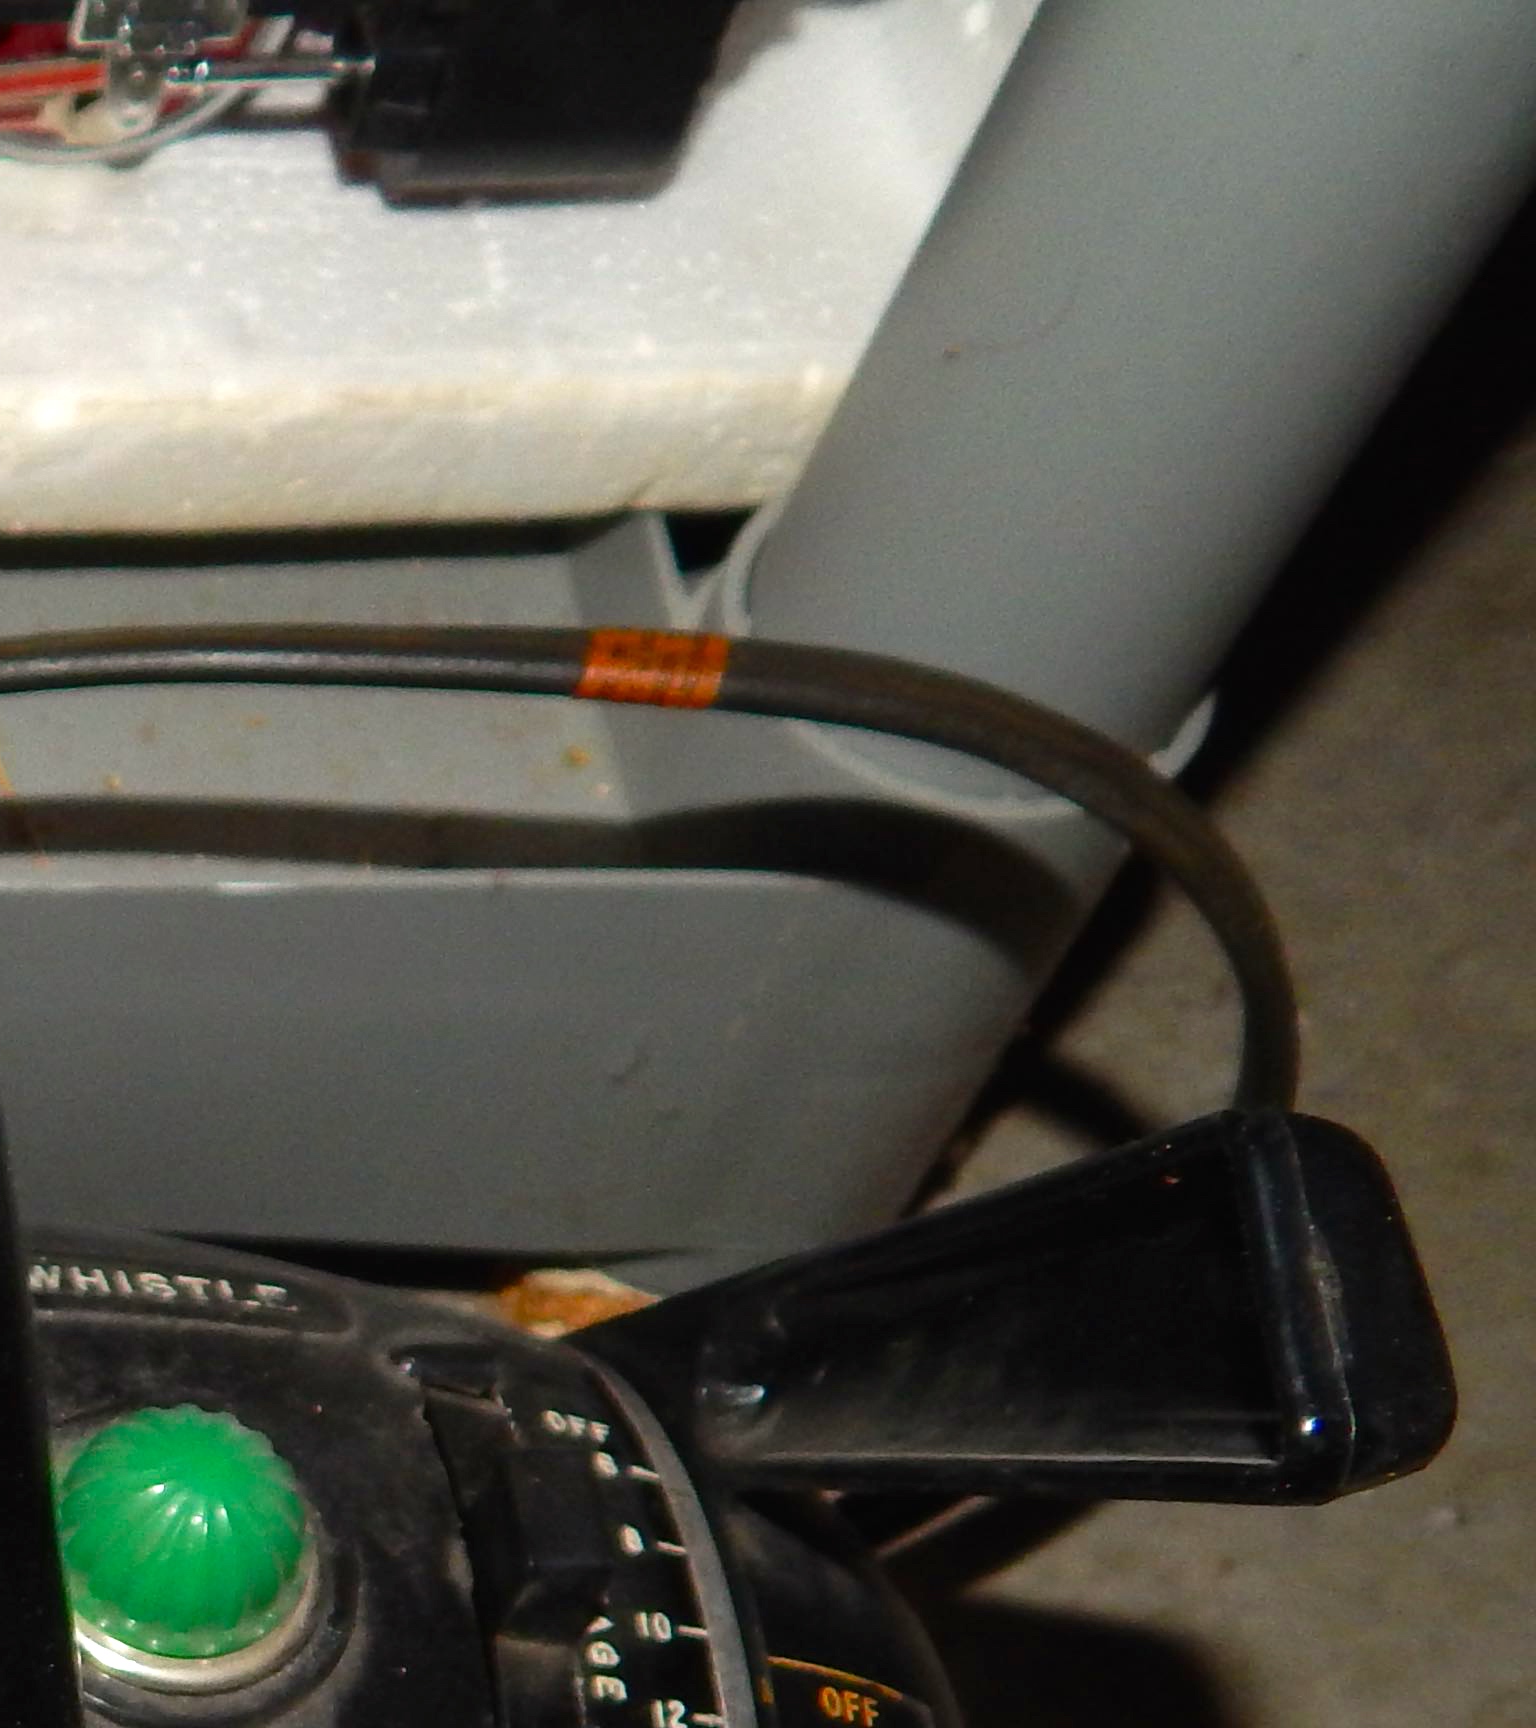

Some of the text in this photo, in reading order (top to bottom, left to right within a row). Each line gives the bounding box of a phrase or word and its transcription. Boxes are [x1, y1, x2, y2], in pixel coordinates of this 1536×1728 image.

[541, 1409, 611, 1443] OFF
[633, 1611, 672, 1642] 10
[817, 1686, 880, 1728] OFF
